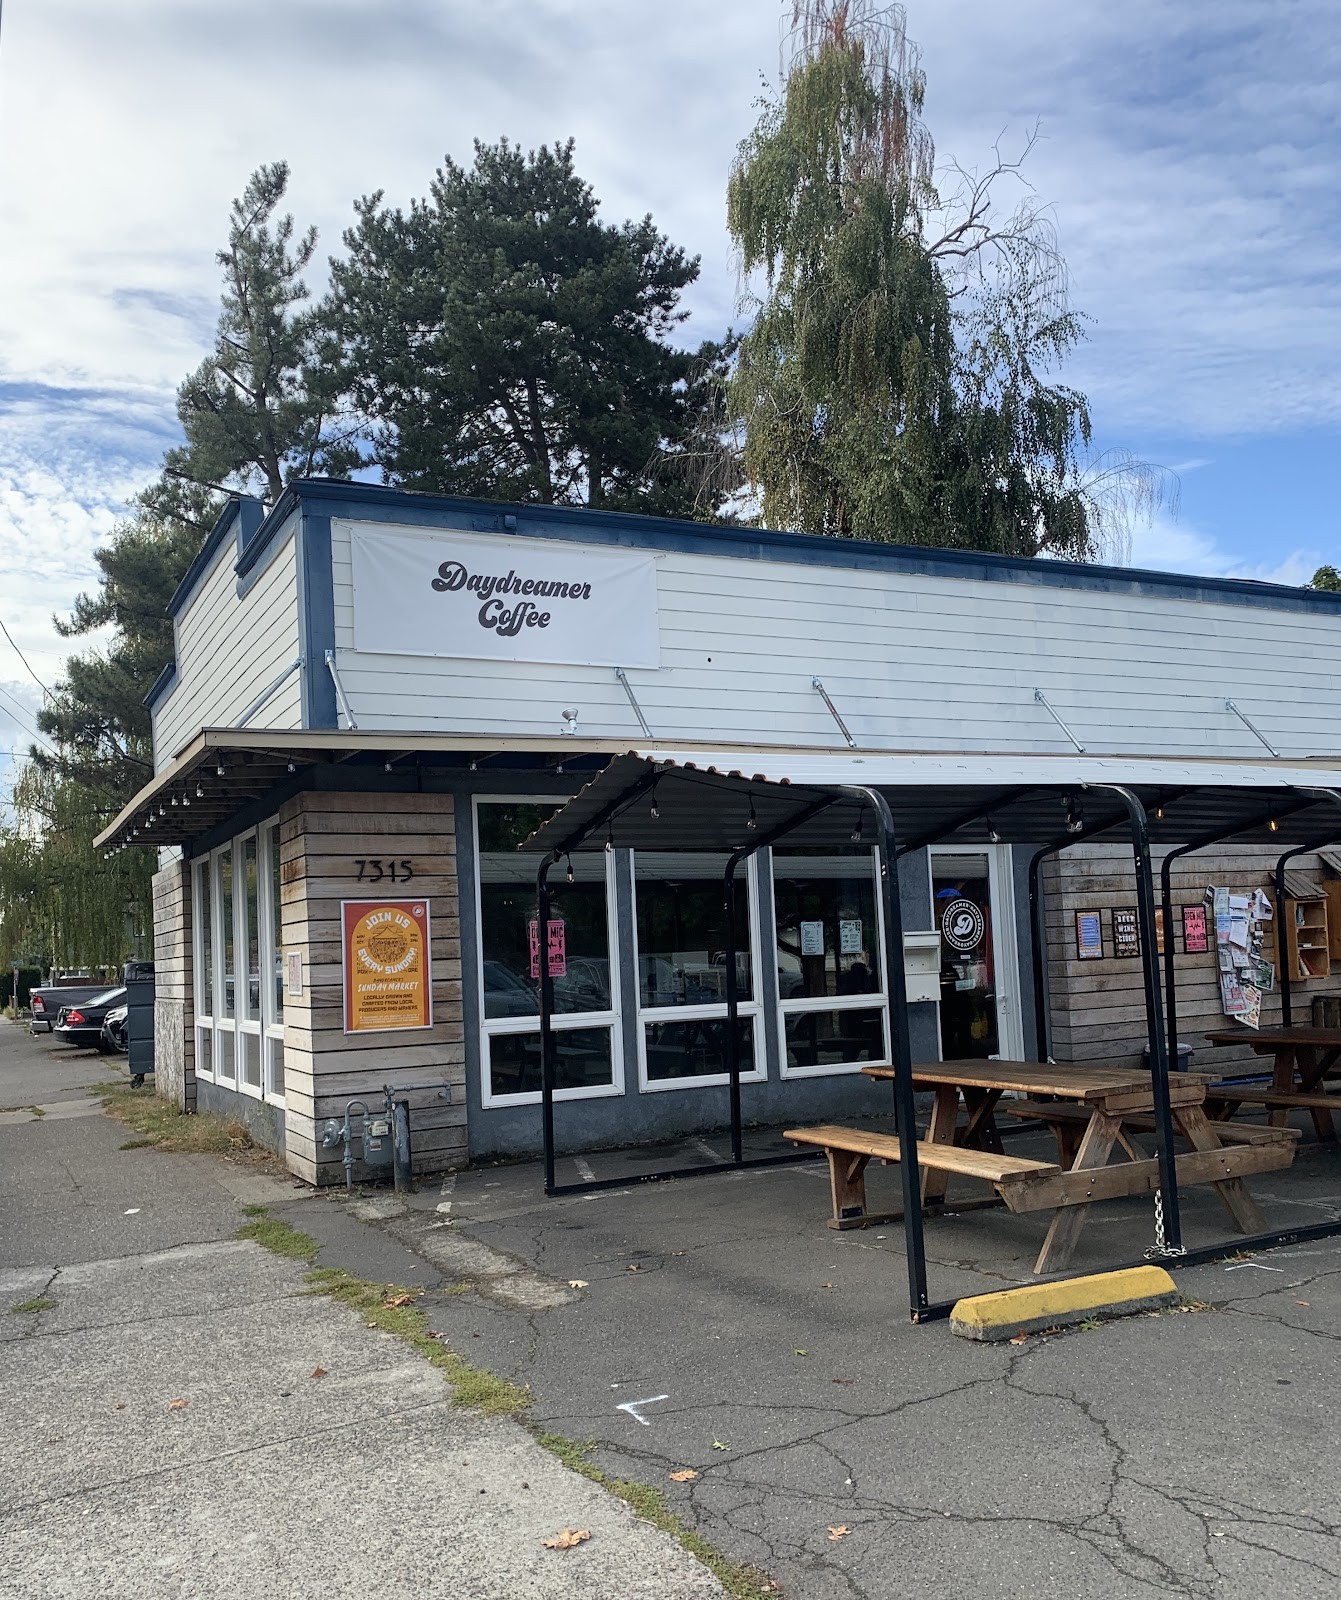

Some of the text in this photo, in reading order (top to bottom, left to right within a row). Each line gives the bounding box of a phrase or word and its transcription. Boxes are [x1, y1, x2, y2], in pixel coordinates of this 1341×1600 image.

[431, 560, 592, 600] Daydreamer
[478, 598, 551, 637] Coffee
[355, 860, 414, 883] 7315
[366, 912, 411, 930] JOIN US
[1117, 915, 1135, 923] BEER
[550, 926, 564, 939] MIC
[1118, 925, 1135, 933] WINE
[1119, 933, 1135, 942] CIDER
[358, 948, 384, 973] EVERY
[358, 981, 419, 993] SUNDAY MARKET
